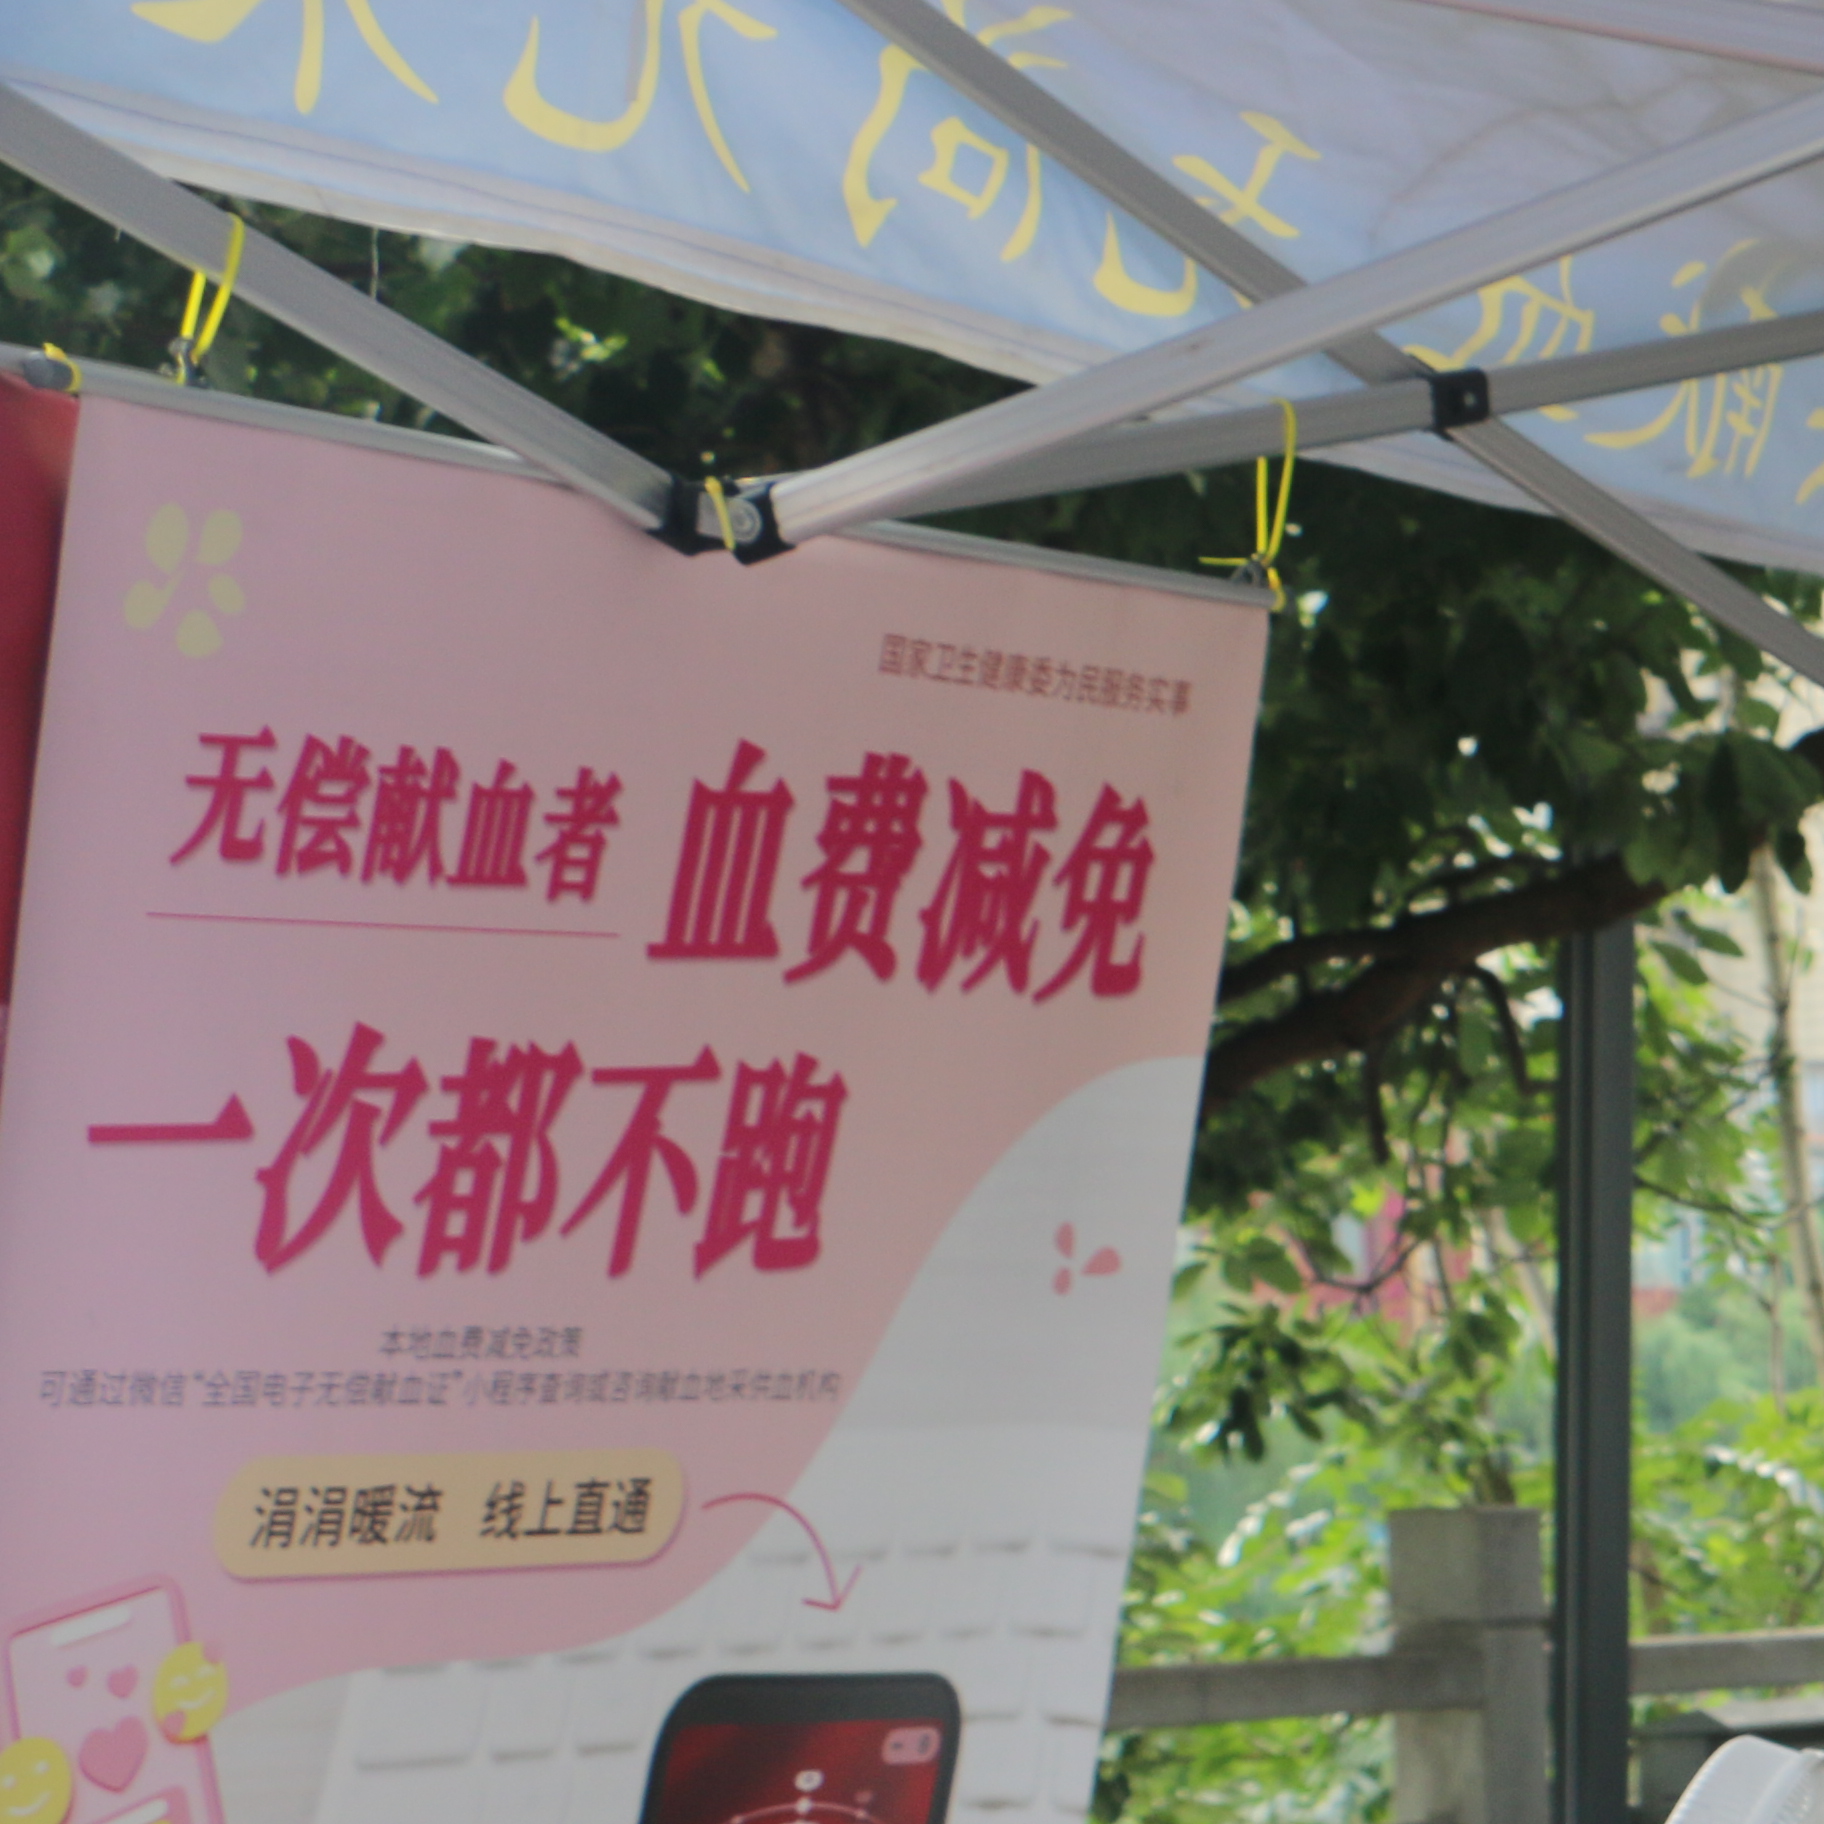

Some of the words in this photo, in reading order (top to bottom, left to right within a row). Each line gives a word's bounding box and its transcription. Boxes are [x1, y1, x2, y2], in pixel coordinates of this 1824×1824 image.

[168, 724, 622, 906] 无偿献血者
[647, 739, 1158, 1003] 血费减免
[87, 1022, 847, 1280] 一次都不跑
[247, 1483, 443, 1551] 涓涓暖流
[478, 1477, 654, 1541] 线上直通
